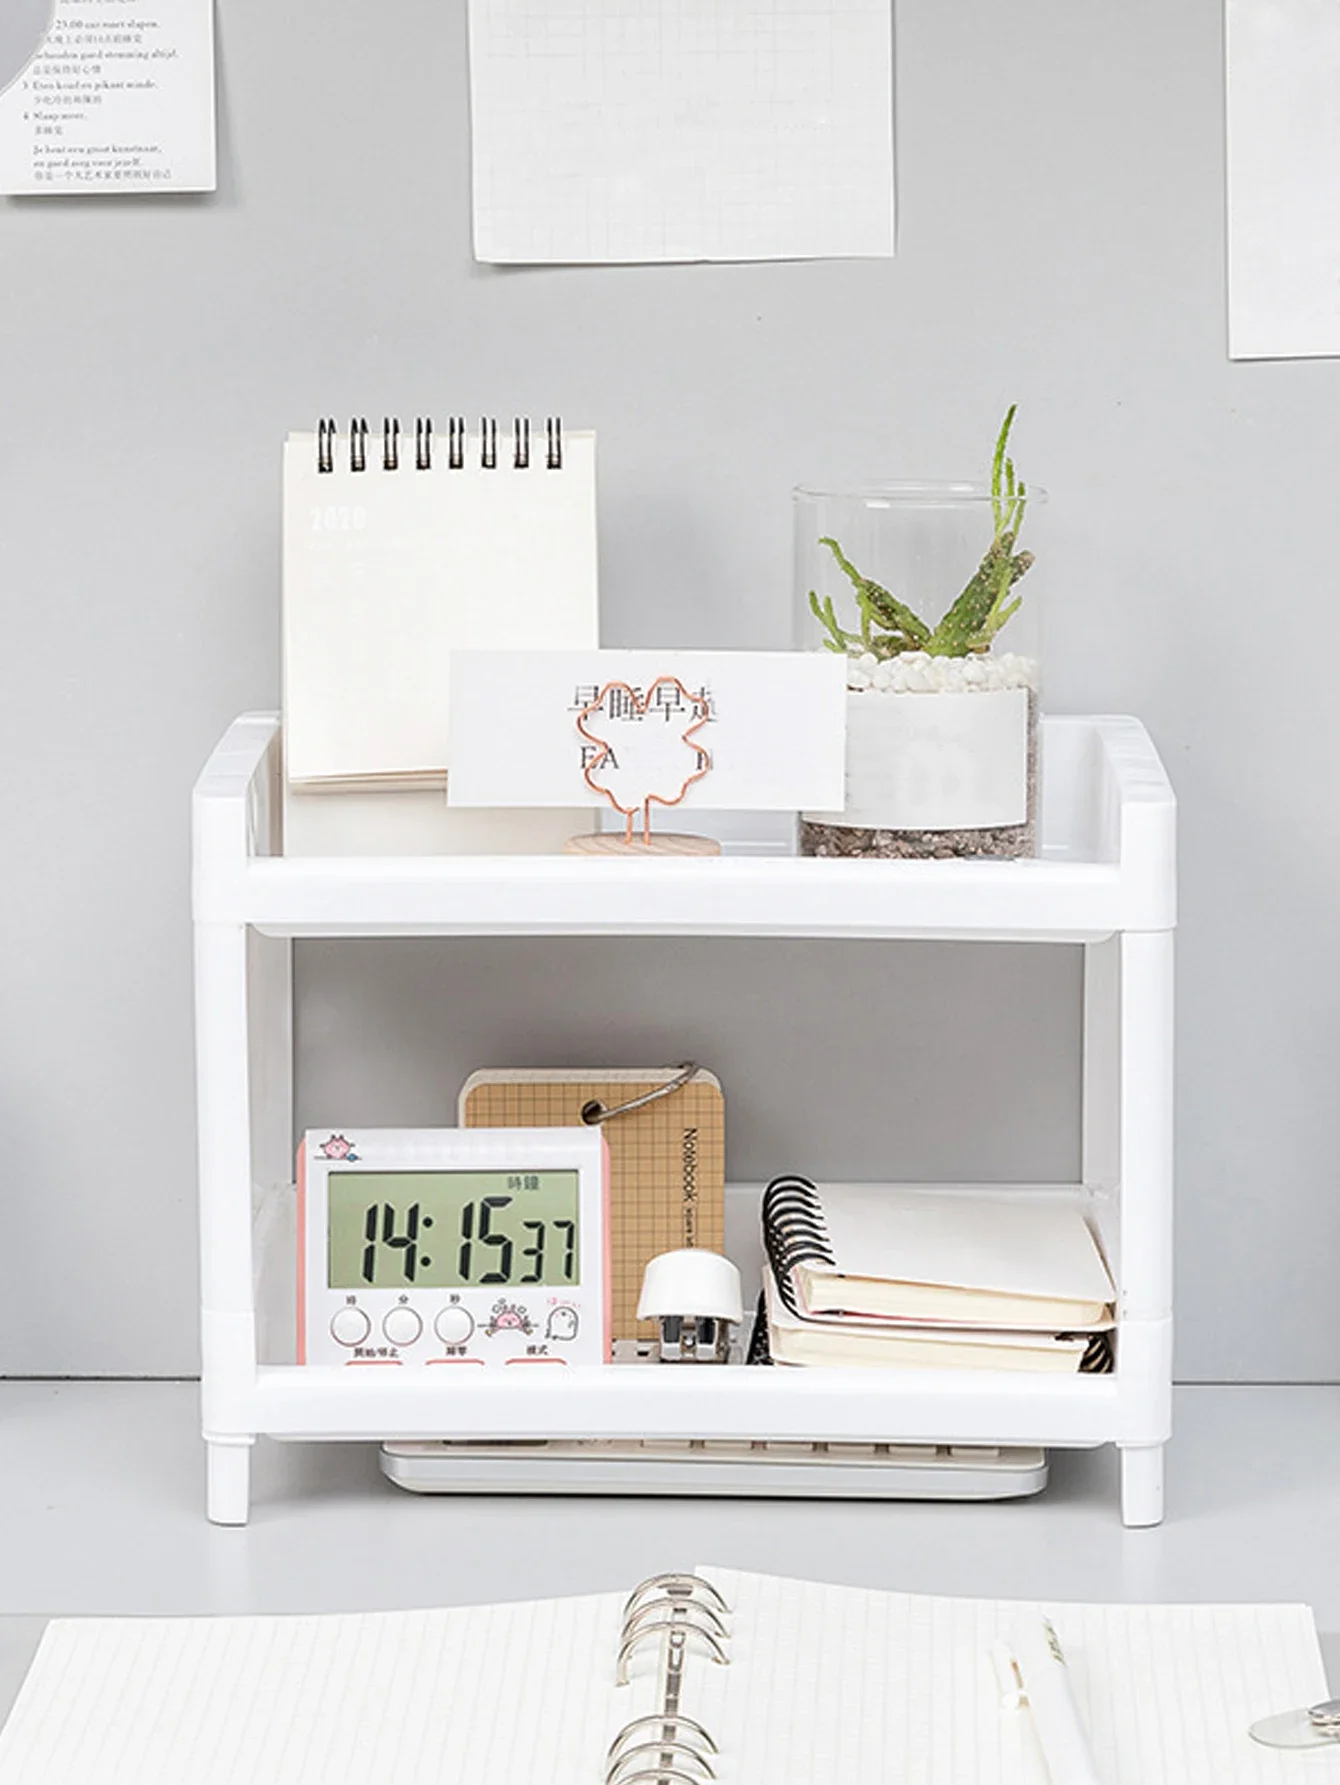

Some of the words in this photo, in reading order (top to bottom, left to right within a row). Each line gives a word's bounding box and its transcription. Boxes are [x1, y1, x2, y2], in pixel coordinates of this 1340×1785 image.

[309, 505, 367, 532] 2020
[683, 1128, 699, 1203] Notebook
[520, 1220, 575, 1284] 37
